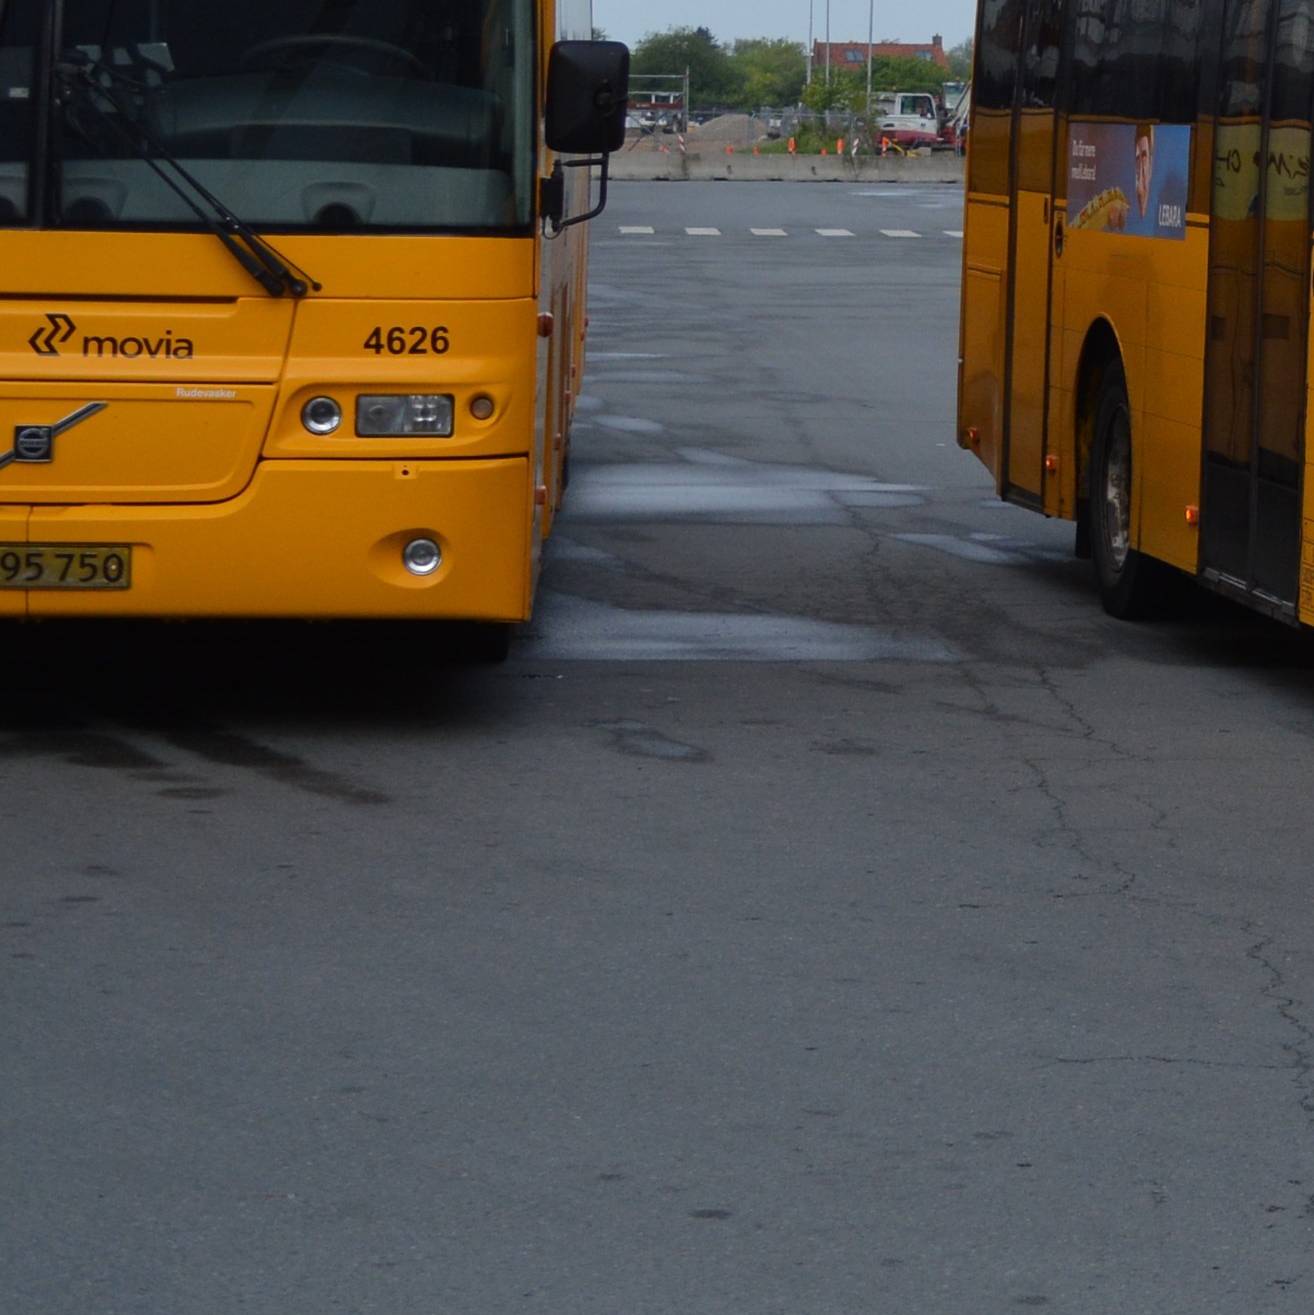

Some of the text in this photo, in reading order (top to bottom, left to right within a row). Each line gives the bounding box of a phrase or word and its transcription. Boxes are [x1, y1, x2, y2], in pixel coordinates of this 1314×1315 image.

[1158, 204, 1182, 229] LEBARA
[82, 329, 195, 360] movia
[362, 325, 451, 355] 4626
[176, 386, 237, 399] Rudevasker
[0, 550, 126, 584] 95 750
